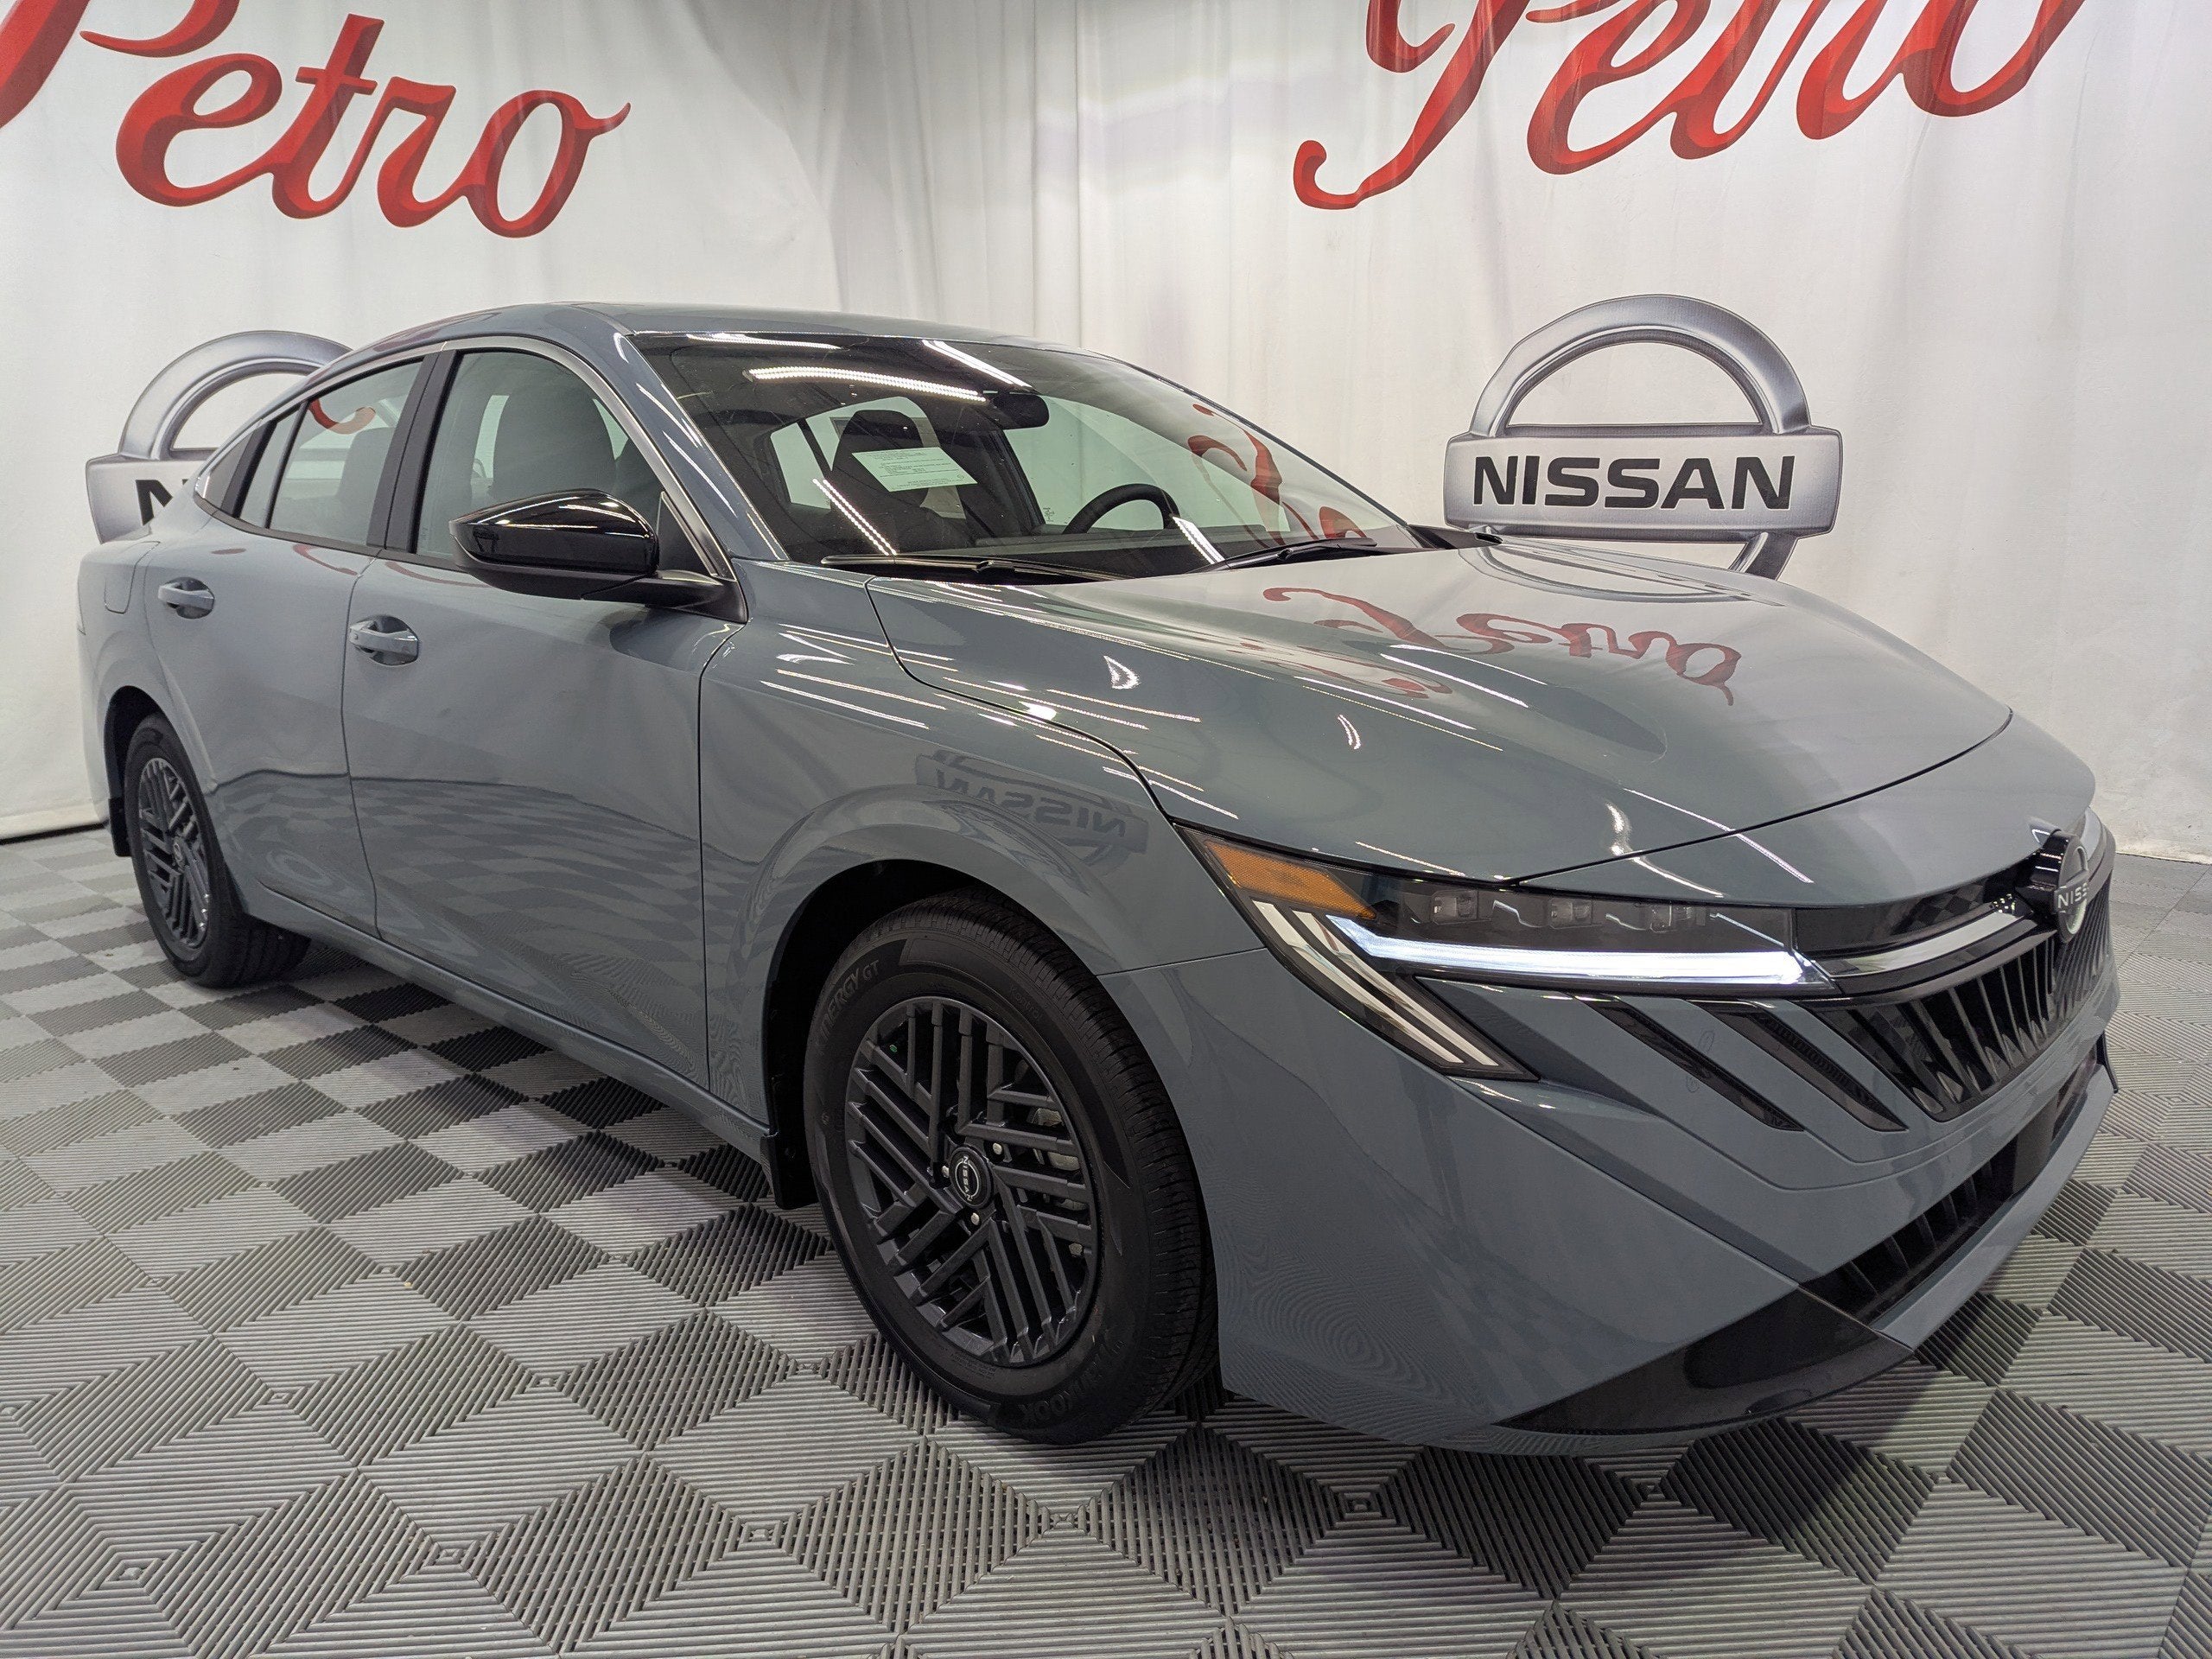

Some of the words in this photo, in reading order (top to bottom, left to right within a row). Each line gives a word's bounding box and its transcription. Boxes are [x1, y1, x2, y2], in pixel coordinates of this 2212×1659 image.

[1472, 455, 1796, 511] NISSAN
[2057, 882, 2088, 909] NISS
[861, 959, 880, 982] GT
